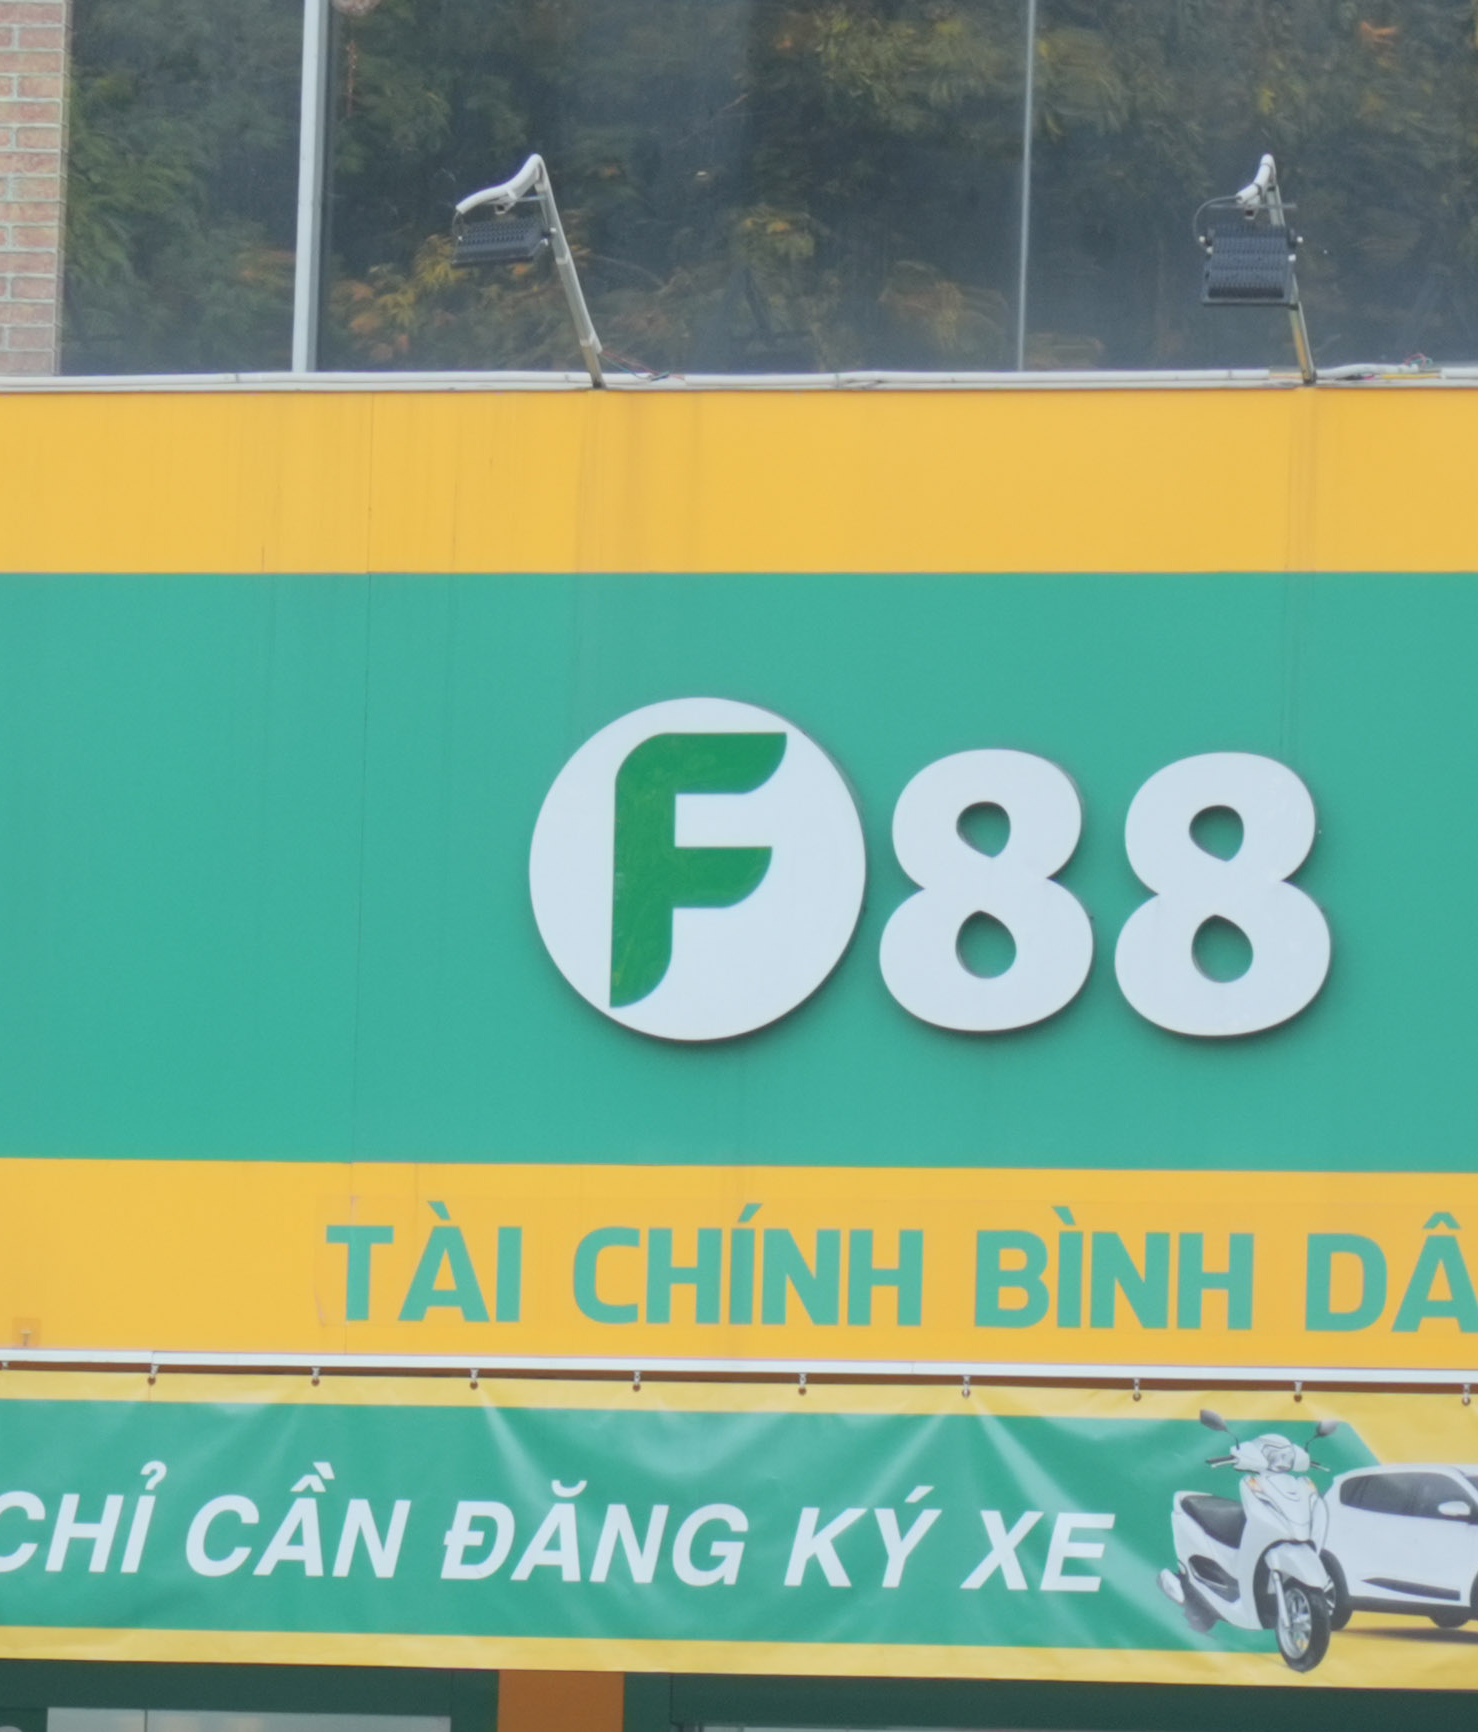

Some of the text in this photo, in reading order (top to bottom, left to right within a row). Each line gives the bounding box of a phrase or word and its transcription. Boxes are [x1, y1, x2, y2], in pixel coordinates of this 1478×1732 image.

[529, 697, 1331, 1040] F88
[326, 1201, 521, 1323] TÀI
[572, 1202, 923, 1327] CHÍNH
[975, 1206, 1252, 1330] BÌNH
[184, 1462, 411, 1579] CẦN
[441, 1479, 749, 1585] ĐĂNG
[785, 1485, 940, 1588] KÝ
[961, 1509, 1115, 1592] XE
